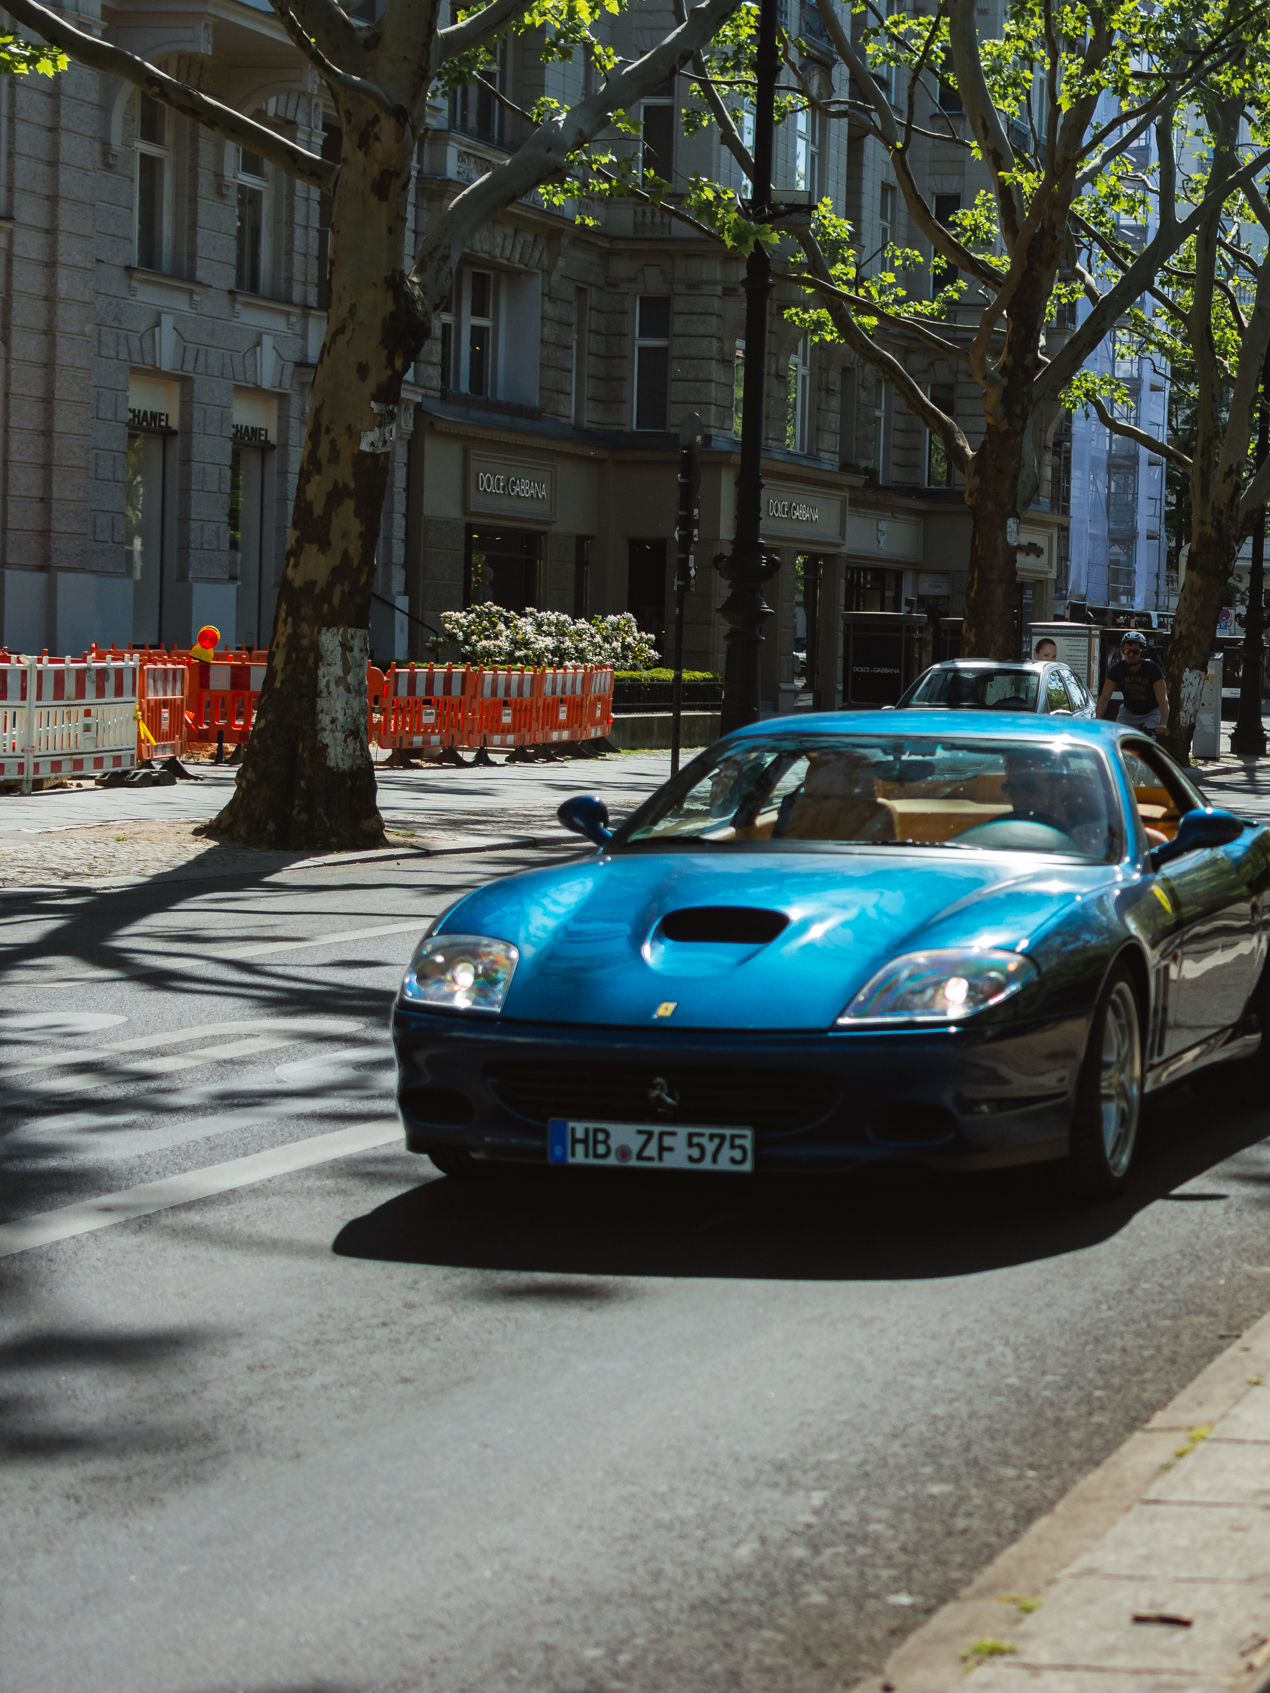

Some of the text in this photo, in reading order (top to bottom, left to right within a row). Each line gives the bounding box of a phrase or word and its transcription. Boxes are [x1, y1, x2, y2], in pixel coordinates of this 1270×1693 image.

[478, 472, 504, 494] DOLCE
[508, 477, 547, 500] GABBANA
[769, 499, 788, 518] DOLCE
[791, 502, 819, 522] GABBANA
[570, 1126, 749, 1166] HB ZF 575
